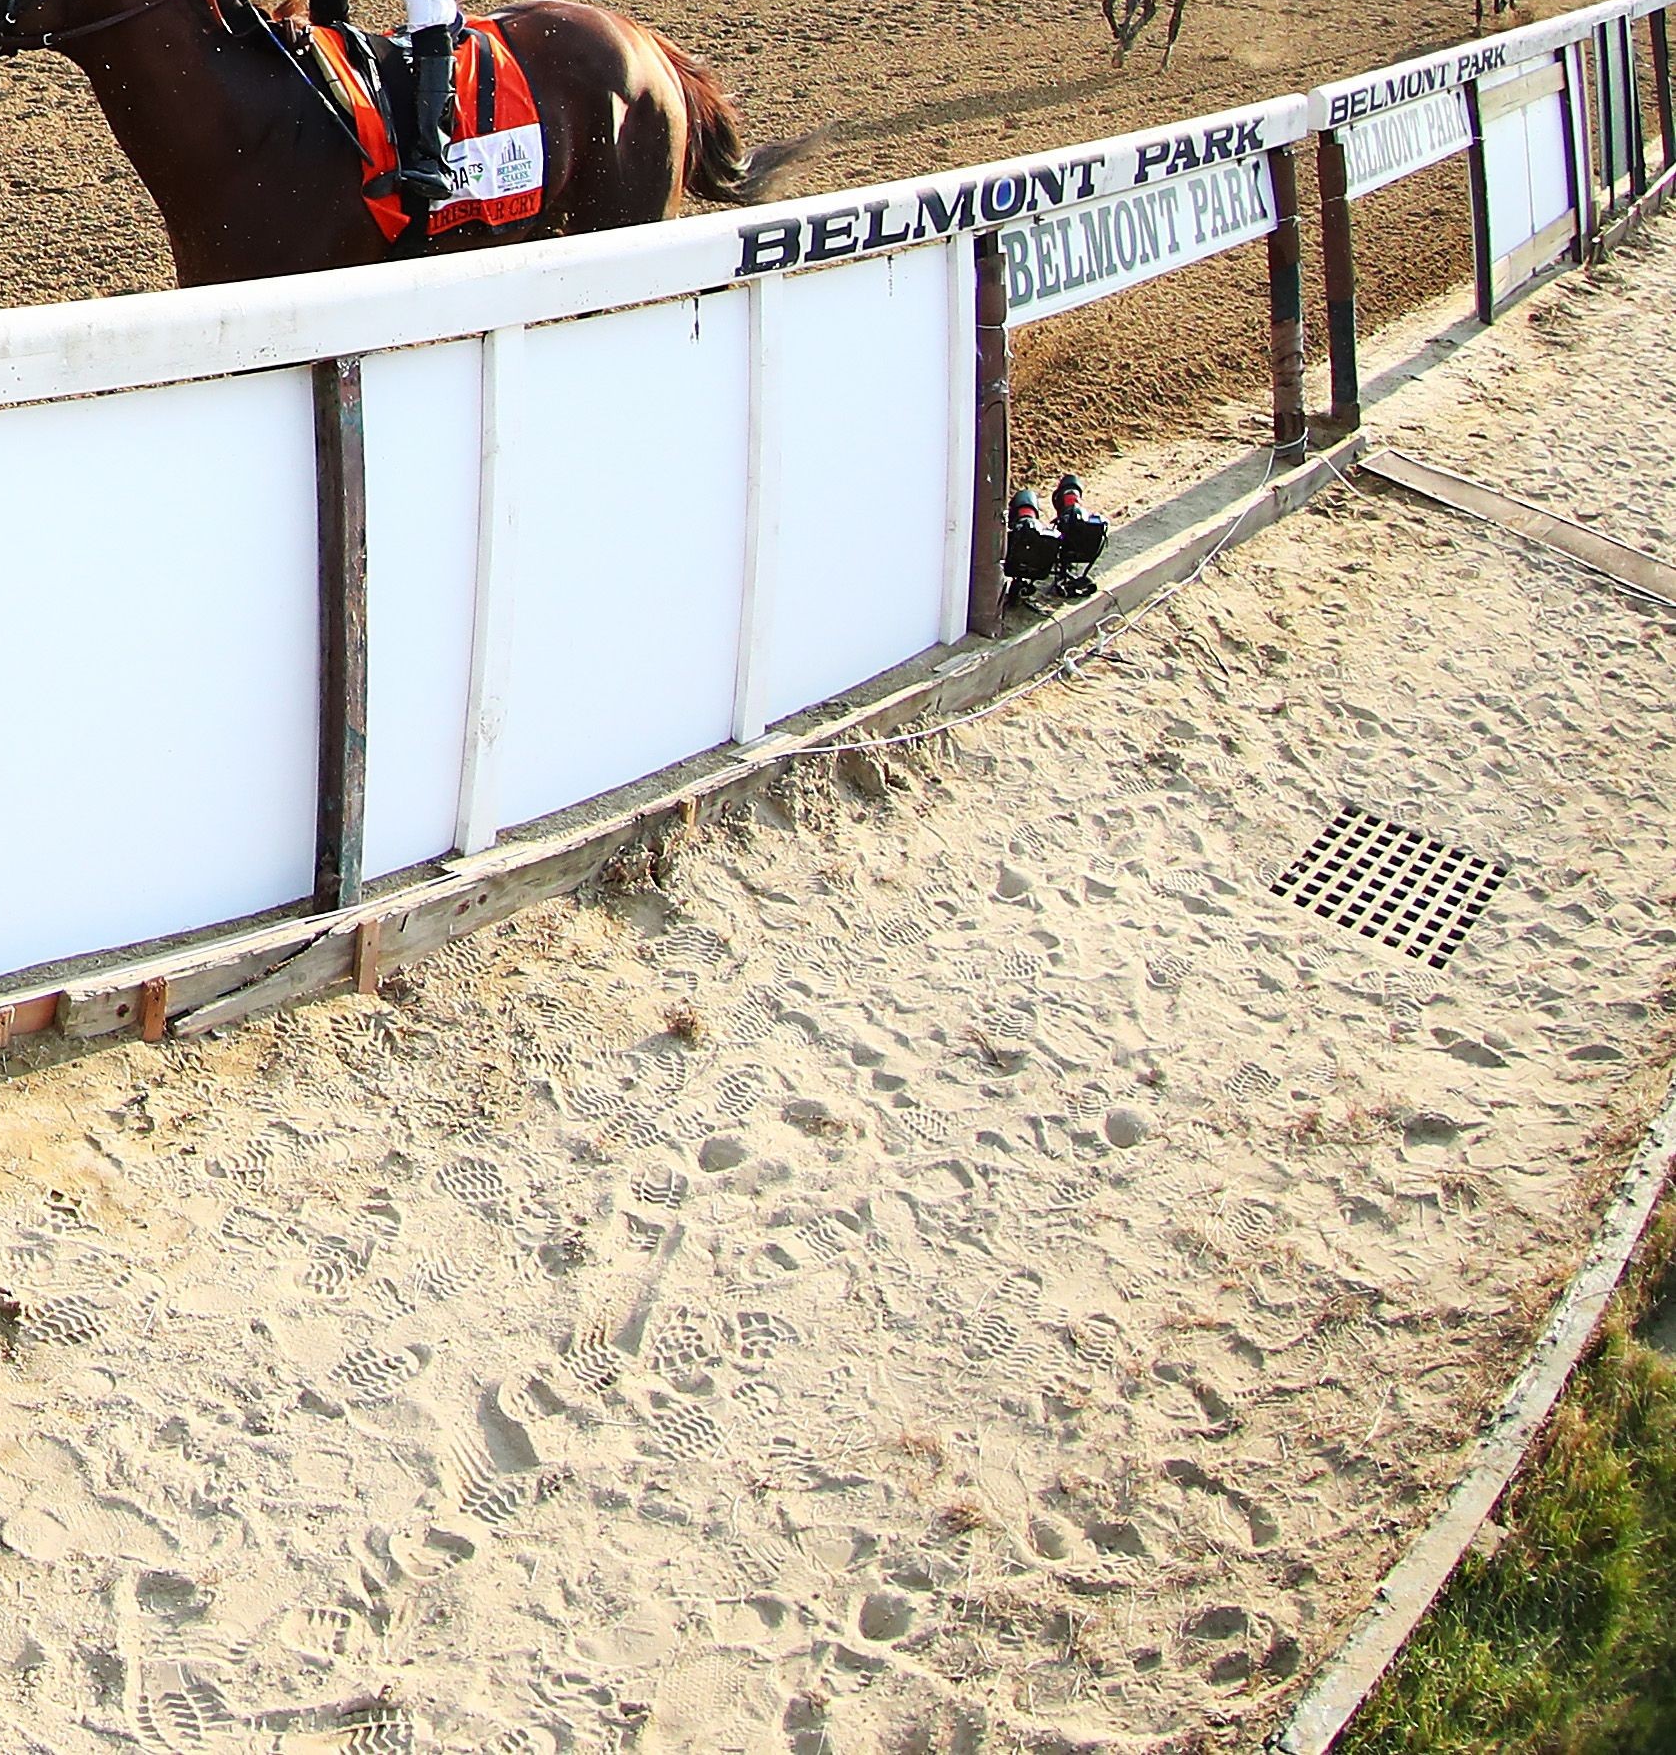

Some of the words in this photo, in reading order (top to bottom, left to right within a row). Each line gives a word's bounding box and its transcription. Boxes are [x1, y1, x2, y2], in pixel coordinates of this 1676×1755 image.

[1329, 64, 1450, 126] BELMONT
[1457, 44, 1507, 83] PARK
[1339, 108, 1423, 185] BELMONT
[1423, 91, 1468, 151] PARK
[734, 157, 1106, 277] BELMONT
[1134, 115, 1266, 184] PARK
[1001, 187, 1181, 308] BELMONT
[1192, 159, 1269, 246] PARK
